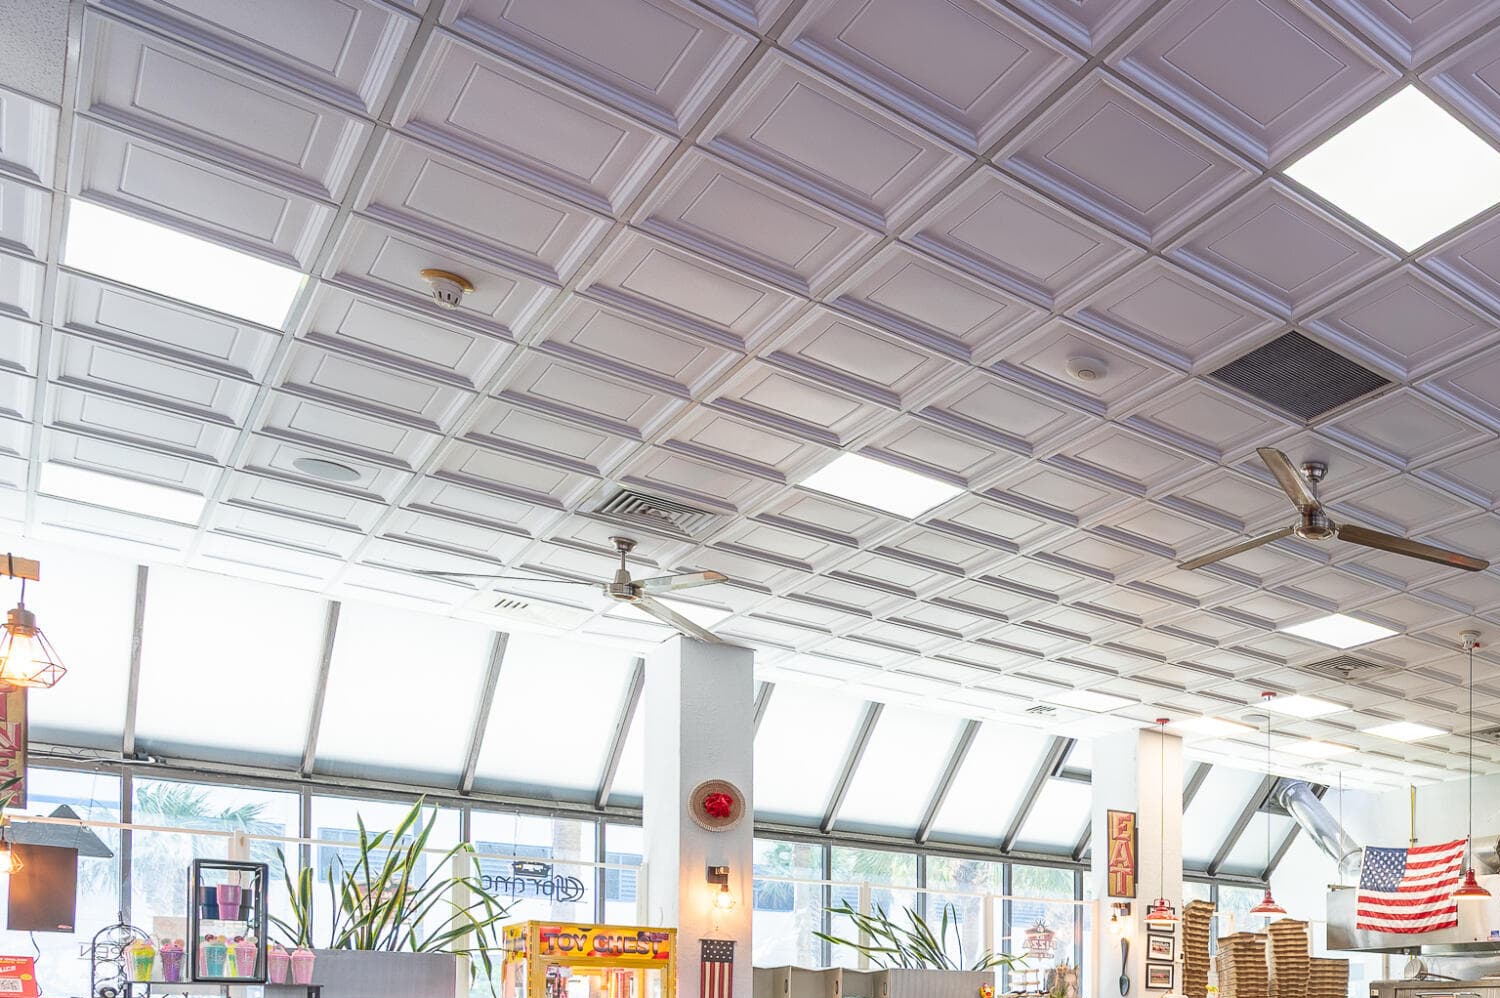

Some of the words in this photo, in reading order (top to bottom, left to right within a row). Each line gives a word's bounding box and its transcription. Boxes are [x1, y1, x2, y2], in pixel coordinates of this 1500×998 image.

[1109, 814, 1134, 896] EAT
[544, 932, 588, 952] TOY
[593, 932, 663, 955] CHEST
